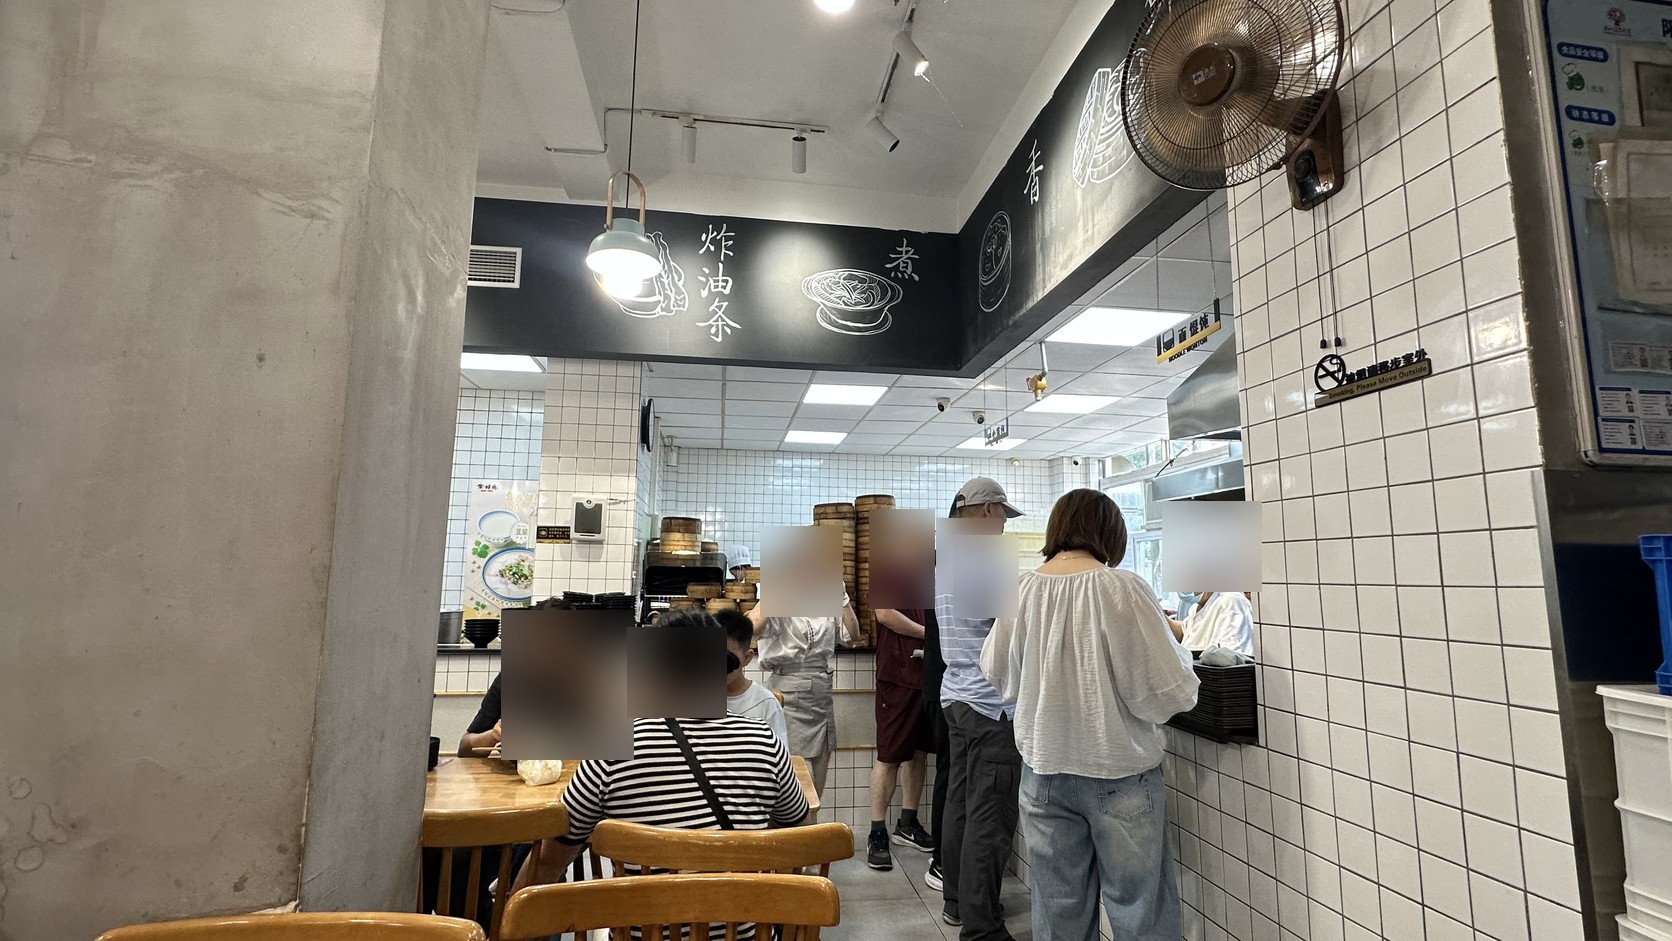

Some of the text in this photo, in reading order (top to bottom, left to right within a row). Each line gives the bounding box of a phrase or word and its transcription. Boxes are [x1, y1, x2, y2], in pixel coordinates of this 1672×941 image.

[1022, 139, 1045, 206] 香
[696, 223, 742, 343] 炸油条
[885, 239, 921, 282] 煮
[1356, 380, 1377, 391] Please
[1378, 374, 1398, 386] Move
[1399, 364, 1427, 380] Outside
